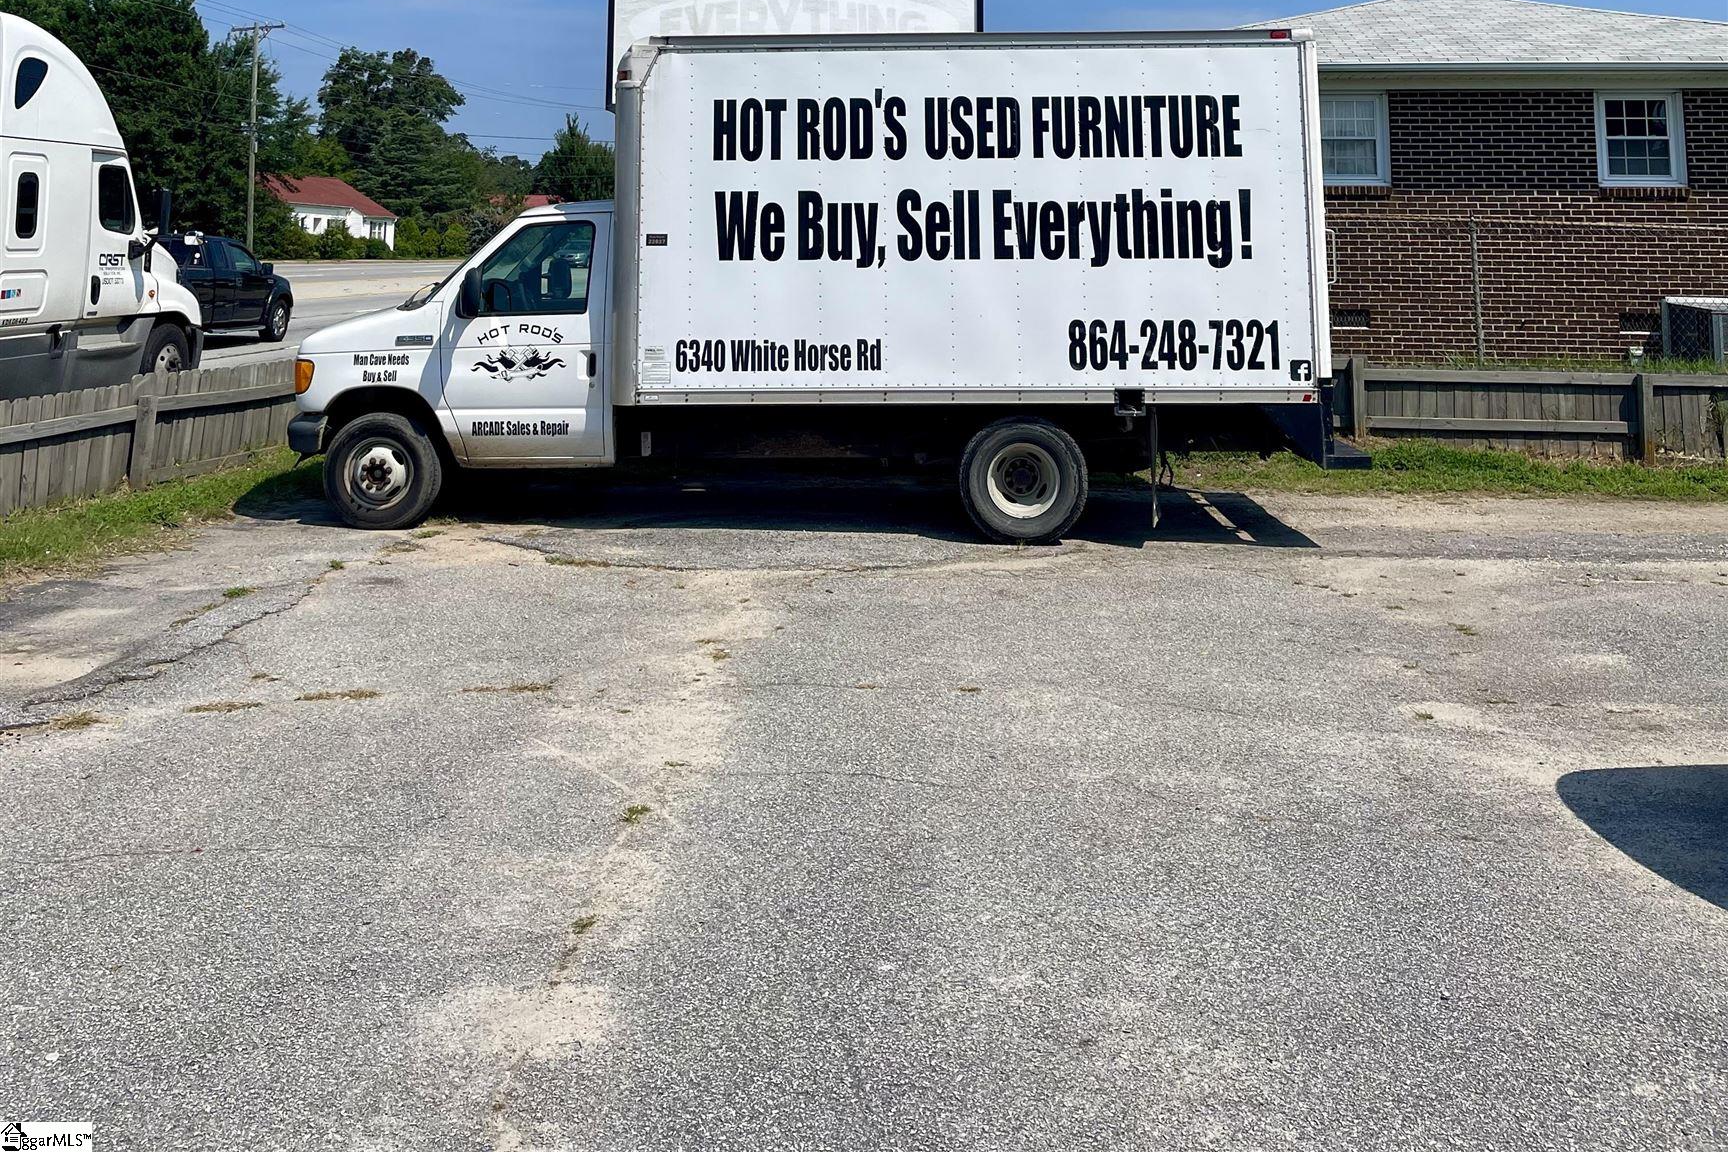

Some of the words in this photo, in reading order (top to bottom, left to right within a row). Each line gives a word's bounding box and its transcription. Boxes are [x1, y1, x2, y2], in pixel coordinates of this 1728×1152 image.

[713, 98, 787, 162] HOT
[797, 87, 908, 161] ROD'S
[924, 95, 1021, 160] USED
[1032, 94, 1243, 159] FURNITURE
[715, 190, 786, 262] We
[797, 190, 887, 268] Buy,
[896, 189, 980, 261] Sell
[993, 187, 1253, 268] Everything!
[477, 325, 510, 344] HOT
[519, 323, 564, 344] ROD'S
[1068, 319, 1280, 371] 864-248-7321
[353, 353, 369, 366] Man
[369, 353, 387, 366] Cave
[388, 353, 410, 366] Needs
[675, 339, 726, 372] 6340
[730, 338, 789, 372] White
[794, 338, 853, 372] Horse
[856, 338, 882, 372] Rd
[362, 370, 376, 383] Buy
[376, 371, 382, 382] &
[383, 369, 398, 382] Sell
[472, 421, 505, 436] ARCADE
[506, 421, 531, 436] Sales
[532, 422, 539, 436] &
[540, 420, 570, 437] Repair
